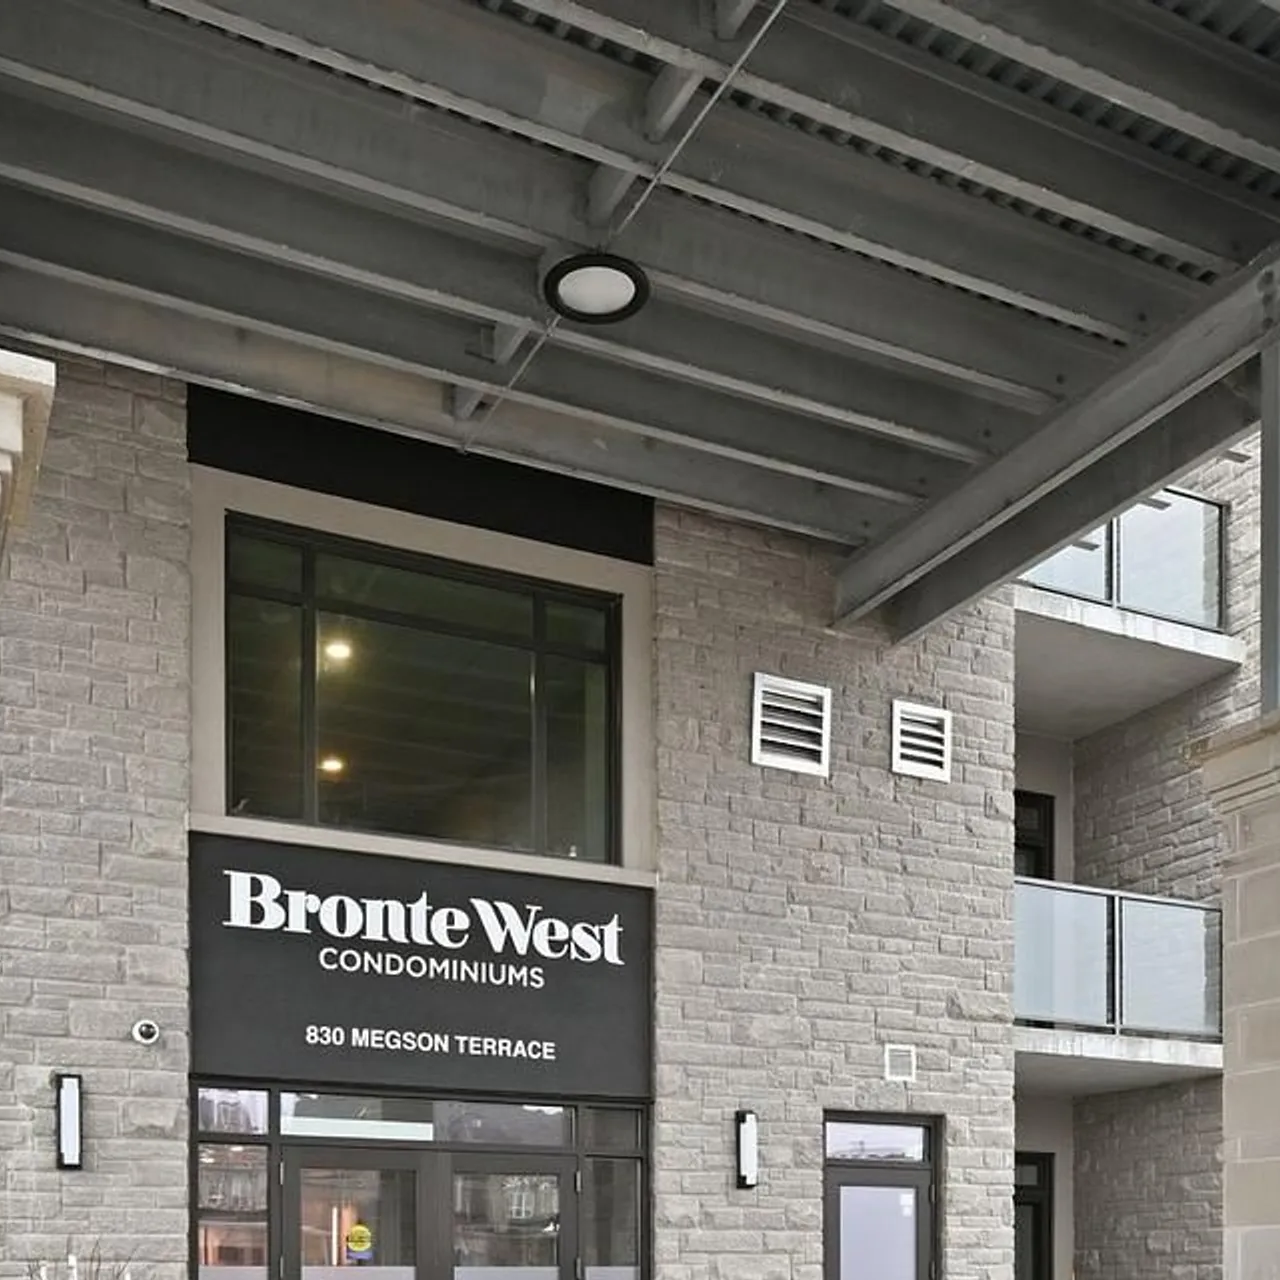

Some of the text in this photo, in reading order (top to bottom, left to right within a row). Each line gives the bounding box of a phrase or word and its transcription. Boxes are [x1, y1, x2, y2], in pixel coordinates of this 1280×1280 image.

[222, 869, 625, 965] Bronte West
[319, 947, 545, 989] CONDOMINIUMS
[305, 1025, 556, 1060] 830 MEGSON TERRACE
